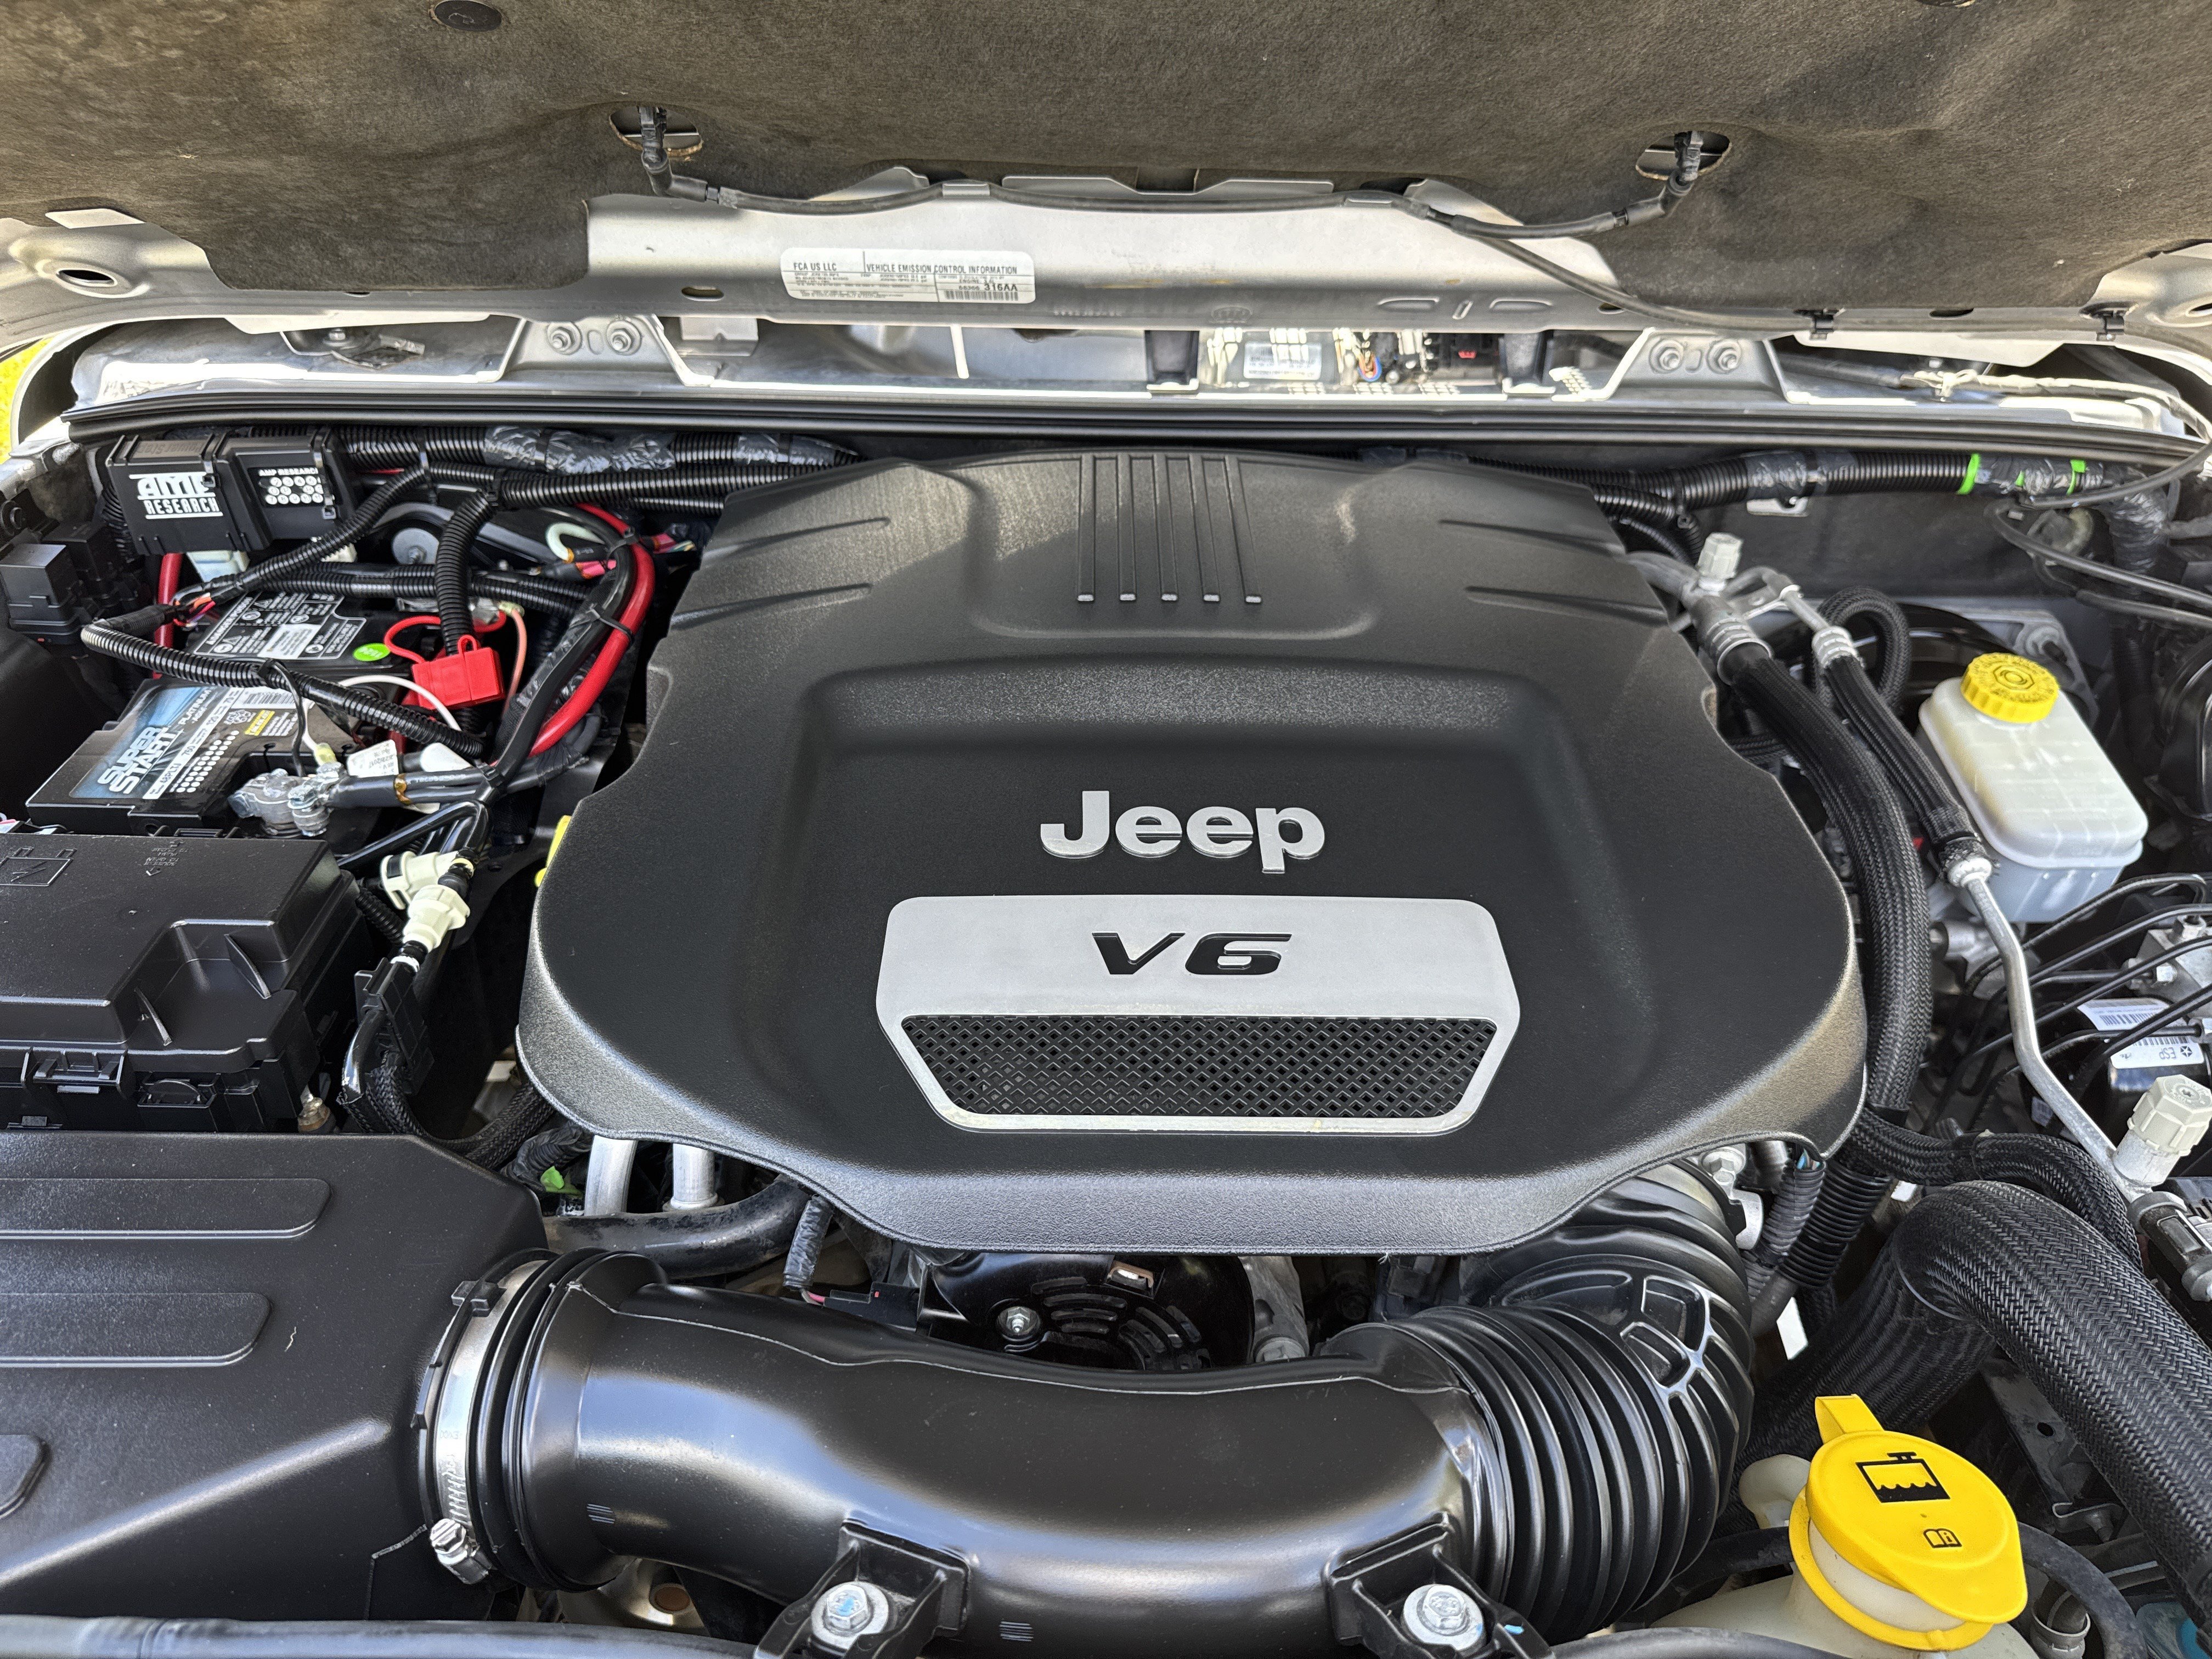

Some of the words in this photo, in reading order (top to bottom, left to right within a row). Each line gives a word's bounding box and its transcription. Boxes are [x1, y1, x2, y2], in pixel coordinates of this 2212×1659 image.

[793, 262, 808, 270] FCA
[823, 263, 837, 271] LLC
[866, 264, 896, 272] VEHICLE
[898, 264, 932, 273] EMISSION
[934, 265, 967, 274] CONTROL
[968, 266, 1017, 274] INFORMATION
[984, 283, 1018, 291] 316AA
[143, 497, 220, 515] RESEARCH
[97, 726, 163, 785] SUPER
[109, 727, 177, 794] START
[1040, 790, 1325, 873] Jeep
[1092, 932, 1293, 975] V6
